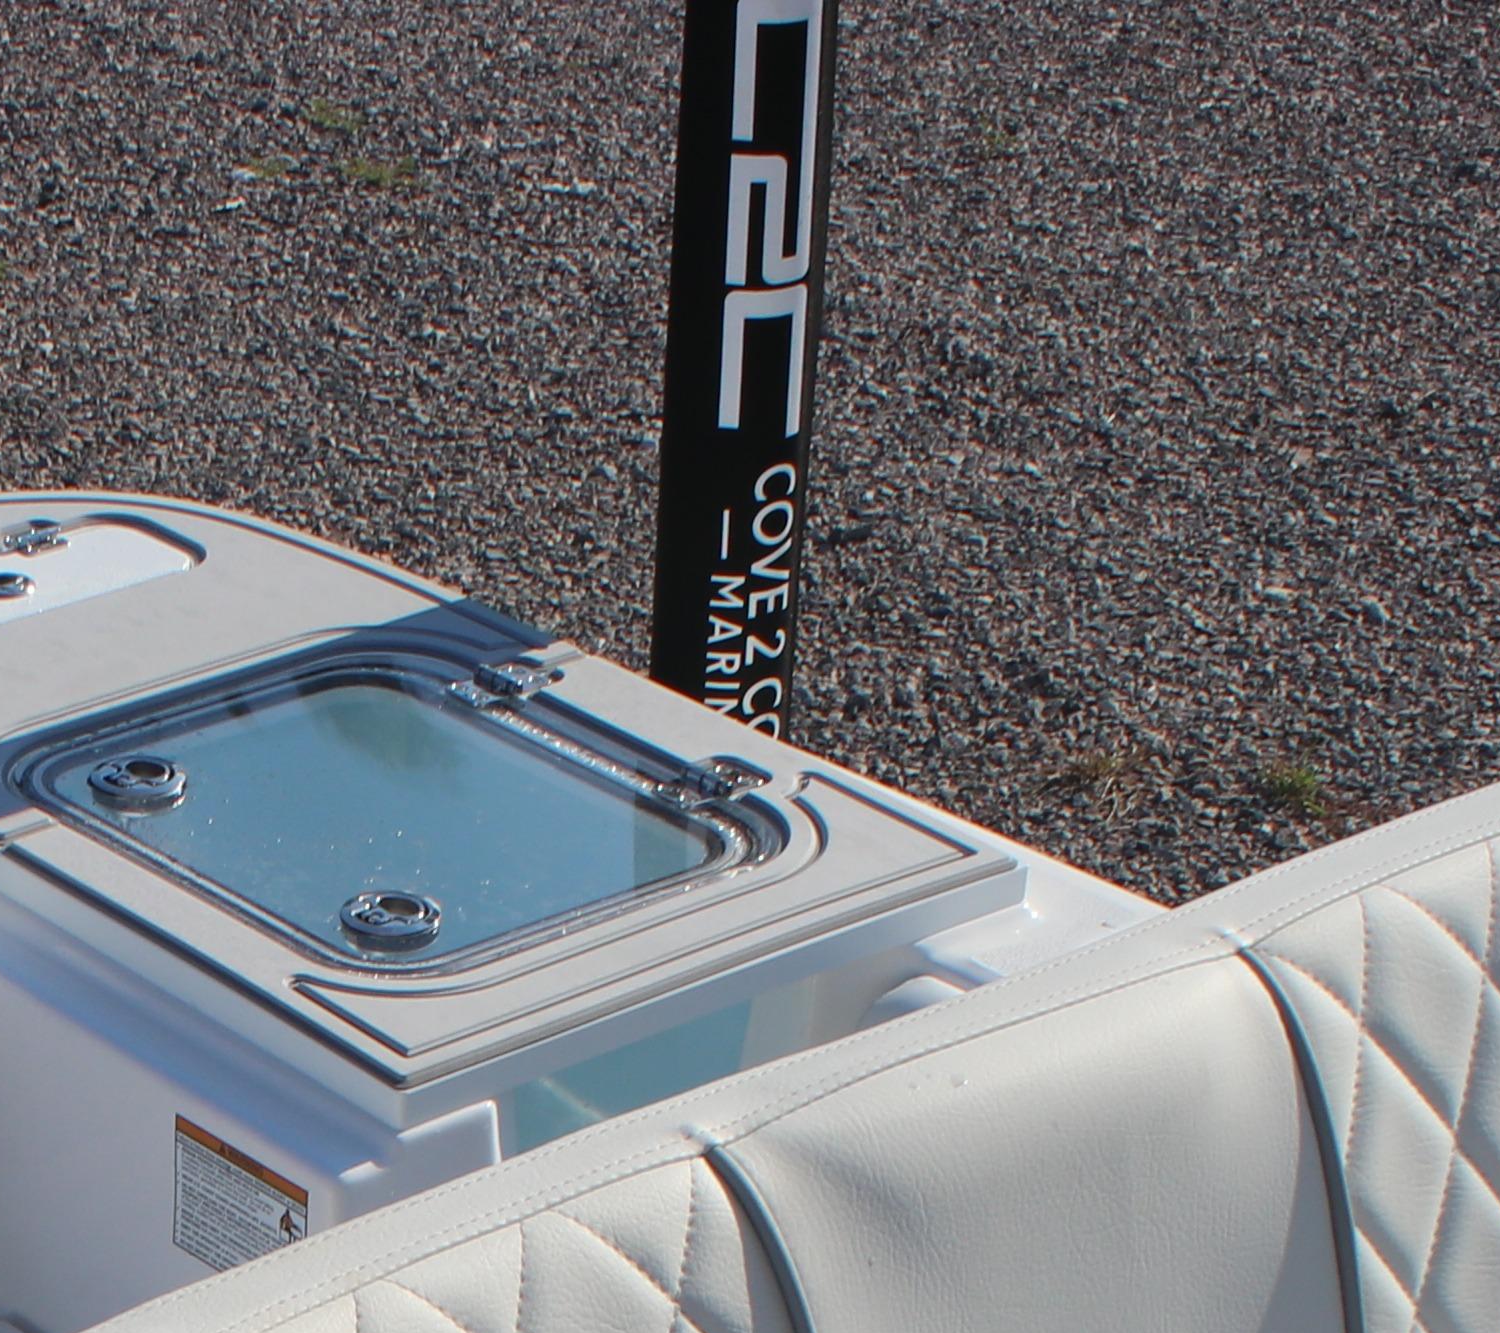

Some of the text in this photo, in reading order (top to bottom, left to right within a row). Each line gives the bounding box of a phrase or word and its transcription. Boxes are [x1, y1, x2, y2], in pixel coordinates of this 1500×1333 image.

[717, 0, 824, 438] C2C
[747, 462, 797, 620] COVE
[744, 628, 787, 667] 2
